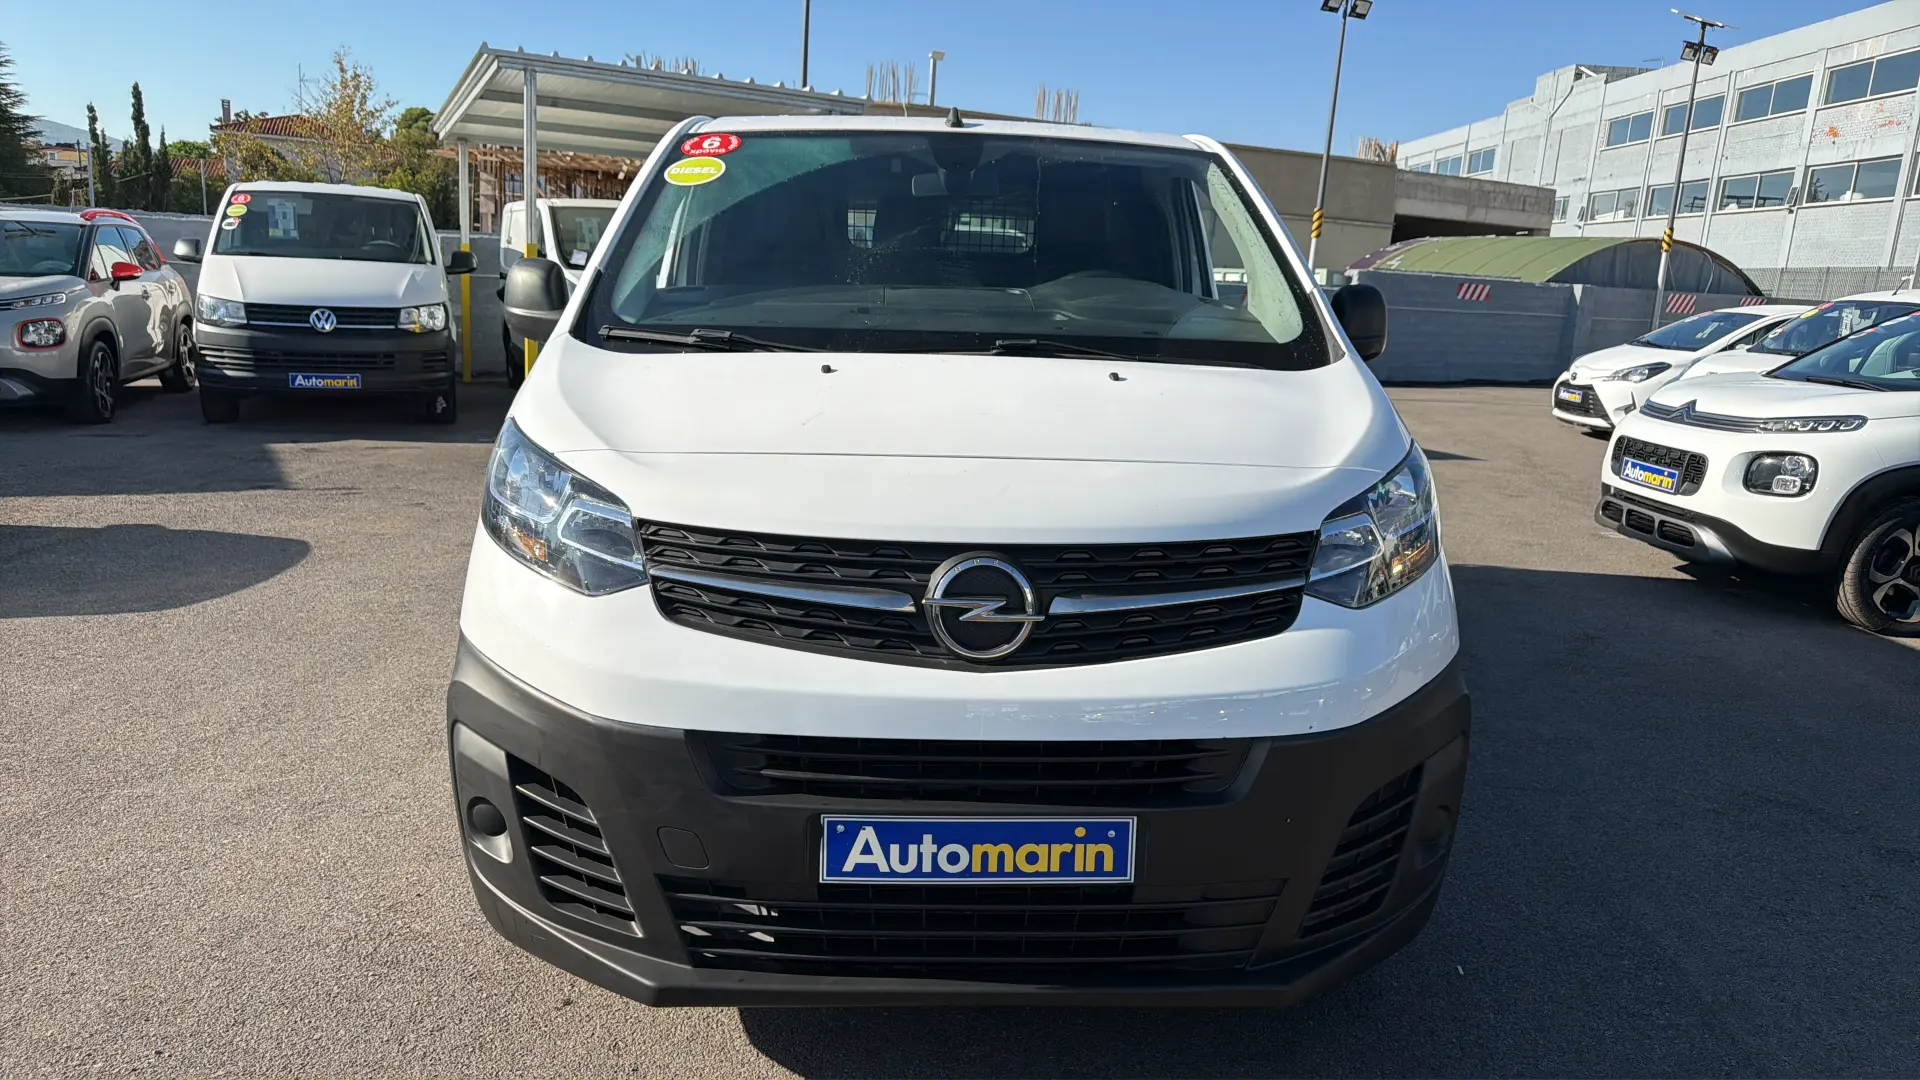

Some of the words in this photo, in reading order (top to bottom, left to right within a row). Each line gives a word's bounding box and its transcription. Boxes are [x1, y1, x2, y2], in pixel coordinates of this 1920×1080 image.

[702, 137, 722, 149] 6
[669, 166, 718, 175] DIESEL
[294, 374, 358, 388] Automarin
[1623, 461, 1673, 489] Automarin
[841, 825, 1114, 873] Automarin
